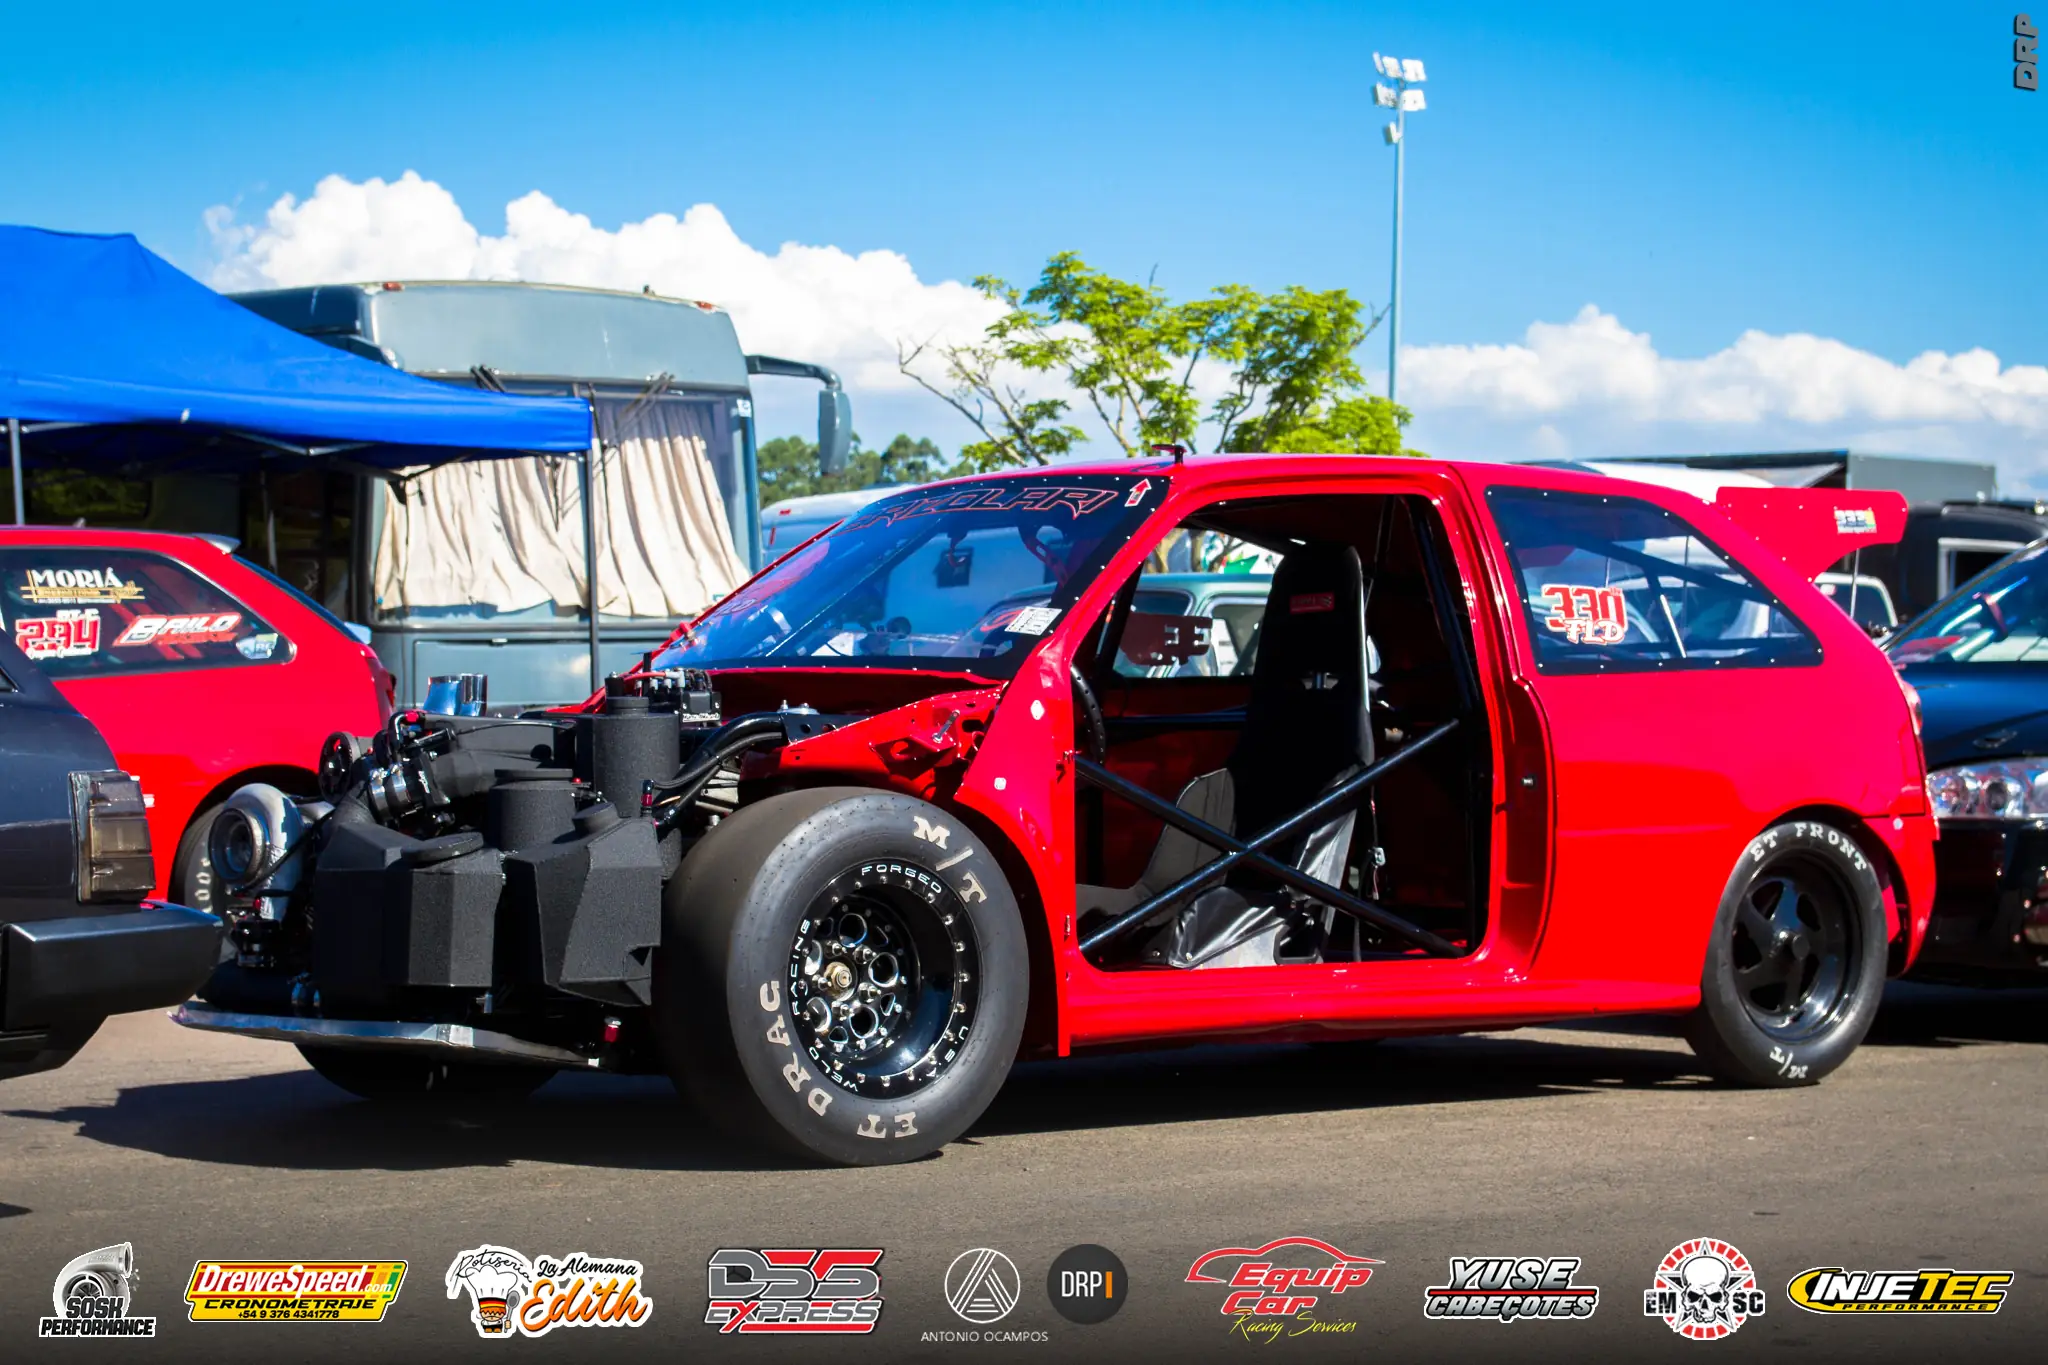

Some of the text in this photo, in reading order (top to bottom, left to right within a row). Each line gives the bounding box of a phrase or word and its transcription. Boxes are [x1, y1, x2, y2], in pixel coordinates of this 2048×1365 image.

[1542, 584, 1628, 632] 330
[913, 815, 987, 903] M/T
[1750, 822, 1867, 871] ET FRONT
[861, 864, 942, 894] FORGED
[790, 919, 811, 1016] RACING
[759, 980, 918, 1139] ET DRAG
[809, 1047, 859, 1092] WELD
[1769, 1046, 1808, 1079] M/T
